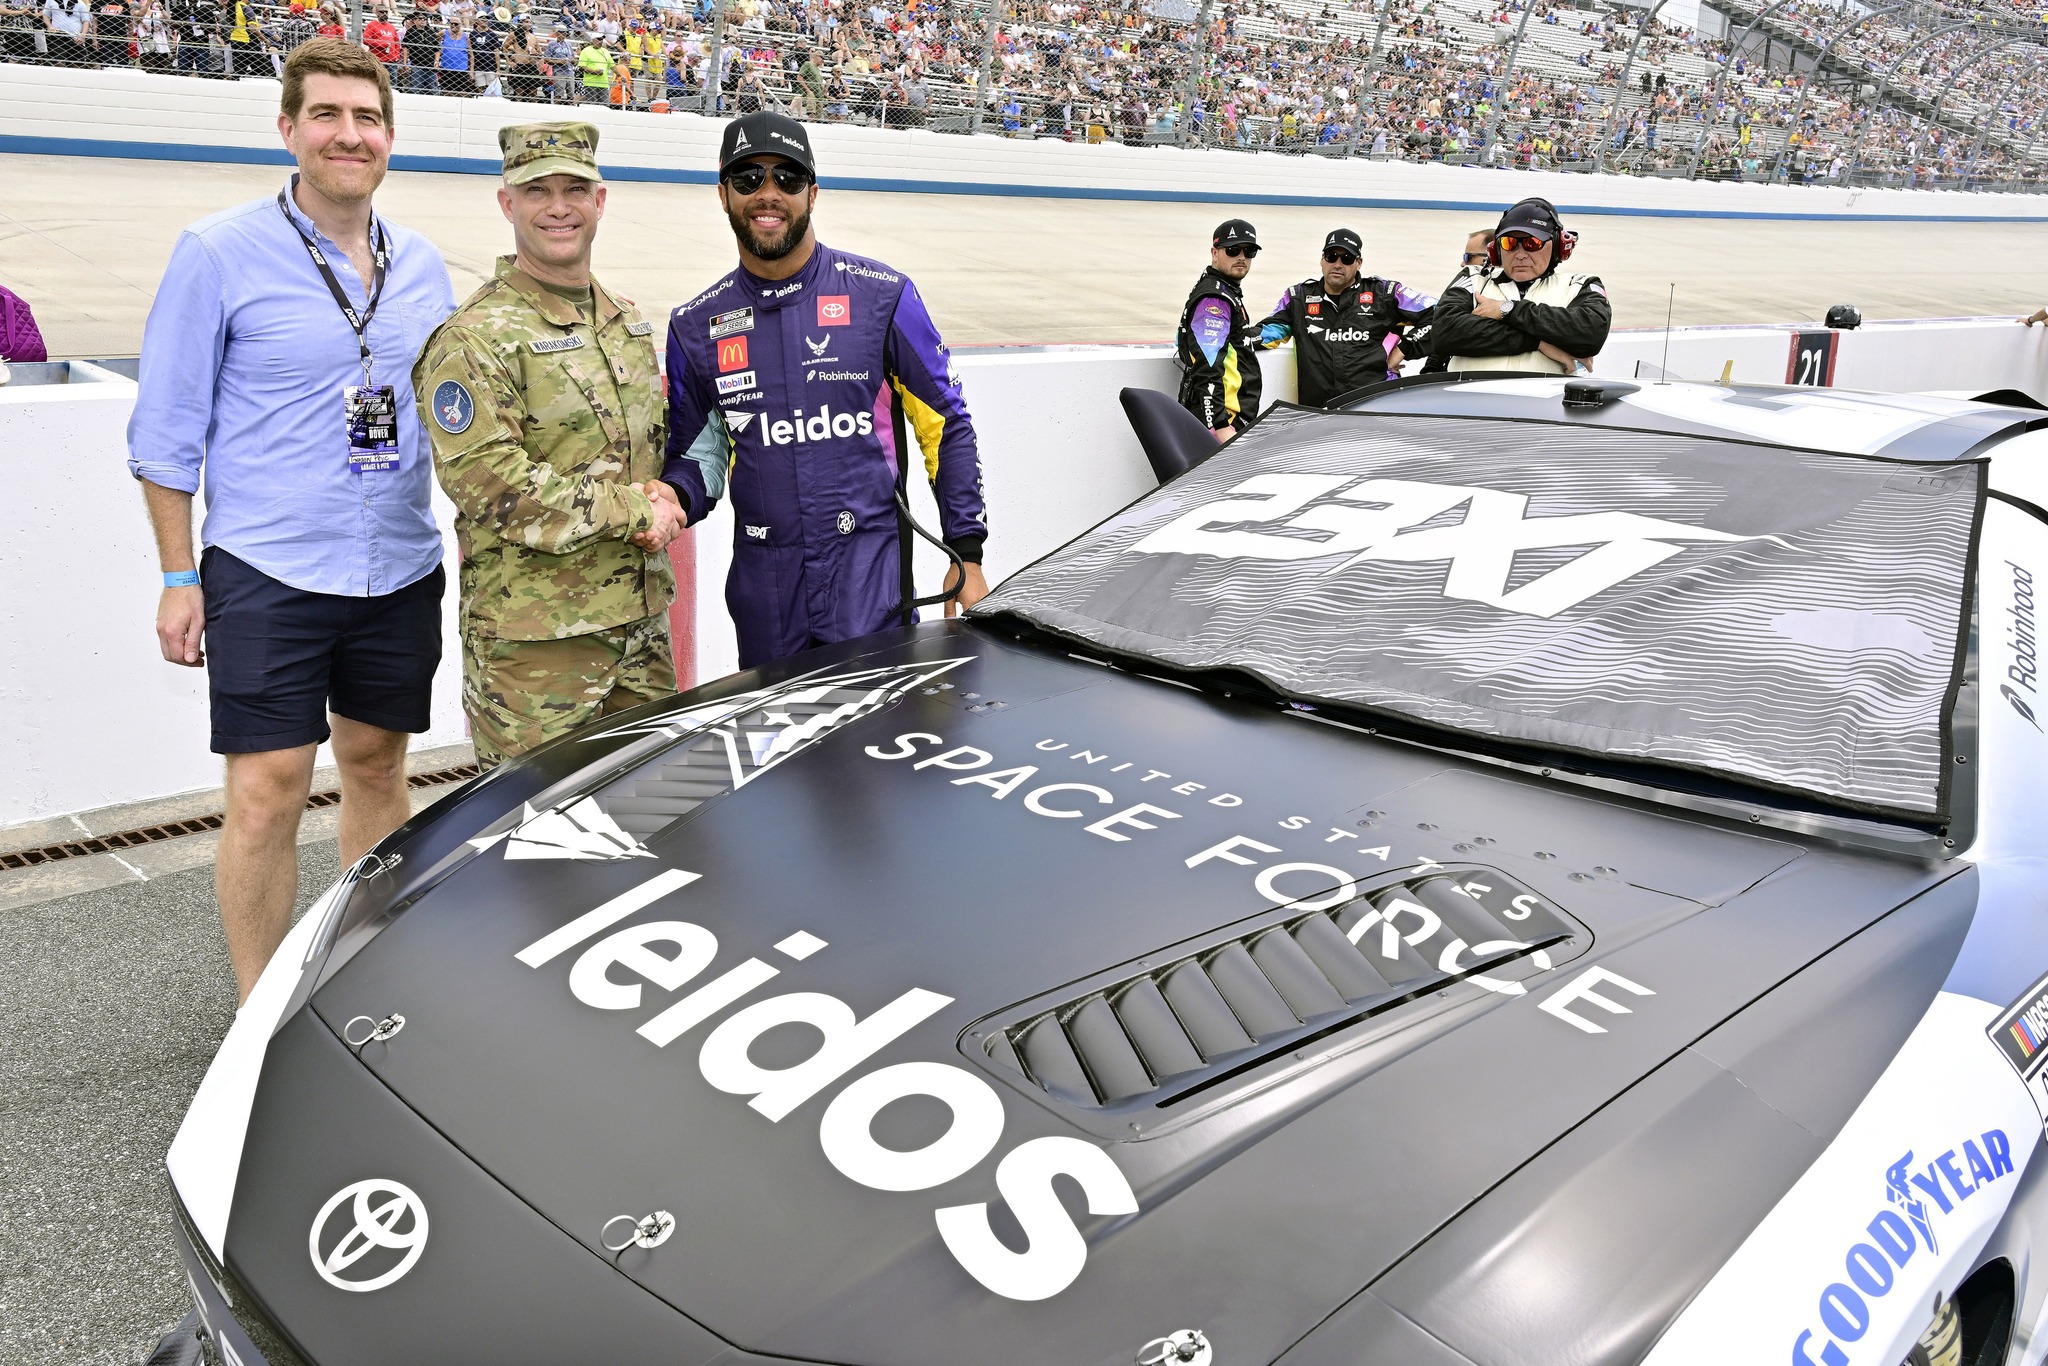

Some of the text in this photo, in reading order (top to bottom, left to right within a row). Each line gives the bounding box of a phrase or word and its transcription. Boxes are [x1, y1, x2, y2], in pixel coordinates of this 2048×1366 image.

[782, 135, 805, 152] leidos
[846, 264, 899, 283] Columbia
[774, 282, 803, 298] leidos
[723, 310, 747, 321] NASCAR
[715, 320, 748, 333] CUP SERIES
[1325, 327, 1370, 341] leidos
[532, 335, 583, 351] WARAKOMSKI
[819, 371, 869, 381] Robinhood
[1799, 349, 1823, 387] 21
[719, 377, 743, 390] Mobil
[1203, 396, 1214, 429] leidos
[369, 428, 389, 439] DOVER
[759, 404, 873, 447] leidos
[2004, 559, 2037, 694] Robinhood
[1035, 738, 1541, 922] UNITED STATES
[864, 732, 1658, 1036] SPACE FORCE
[514, 868, 1141, 1302] leidos
[1791, 1128, 2015, 1366] GOODYEAR
